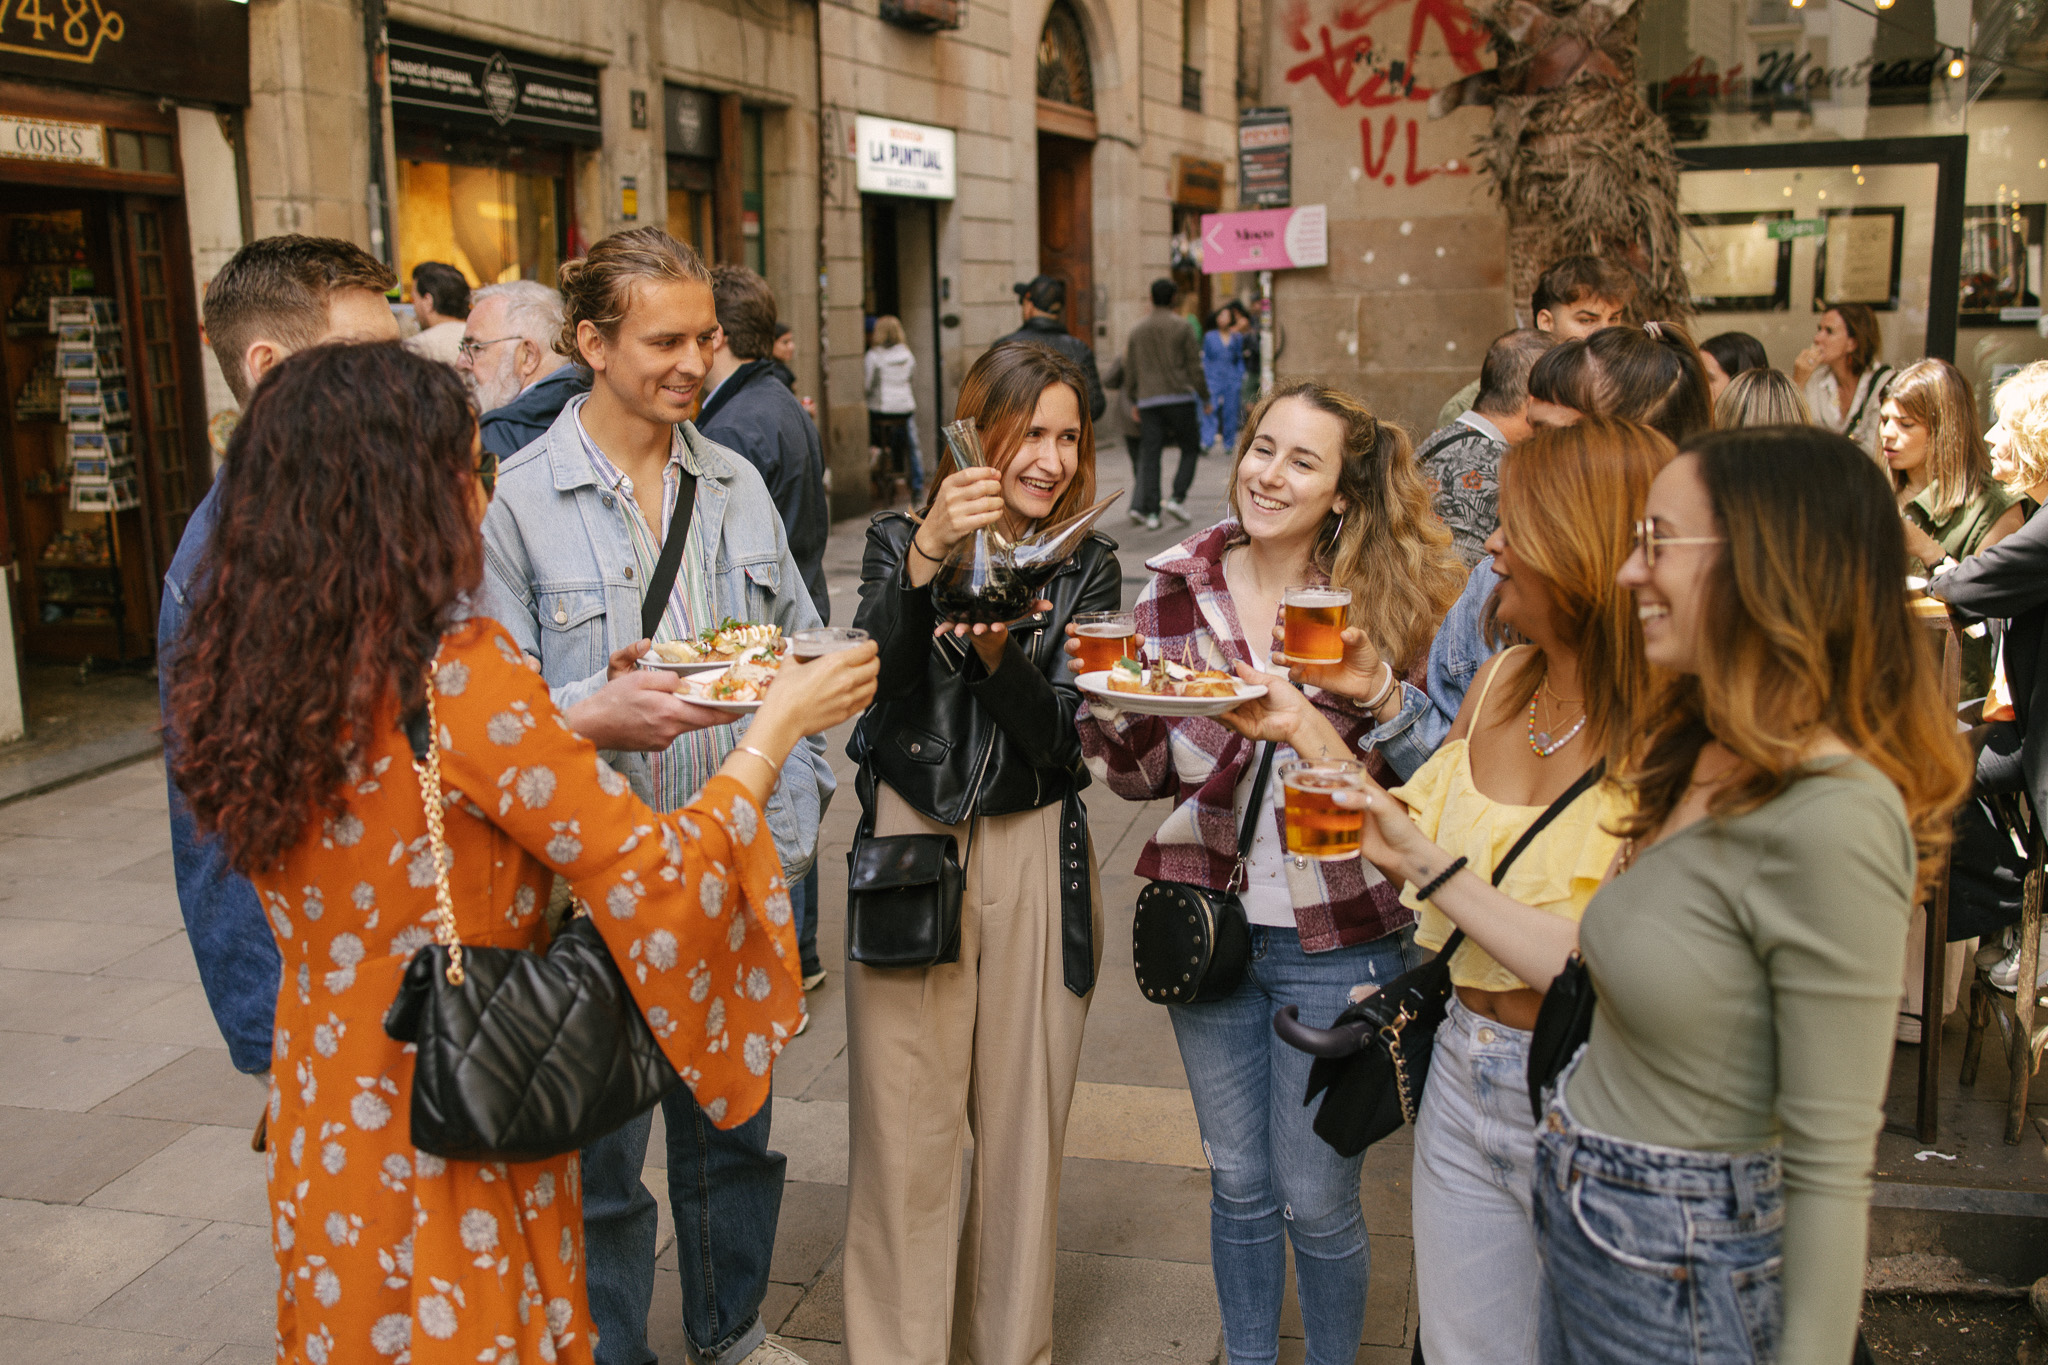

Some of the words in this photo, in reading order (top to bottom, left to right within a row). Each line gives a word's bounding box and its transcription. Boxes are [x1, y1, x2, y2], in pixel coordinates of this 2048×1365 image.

[1660, 55, 1744, 100] Art
[15, 125, 83, 155] COSES
[868, 140, 884, 162] LA
[890, 144, 942, 171] PUNTUAL
